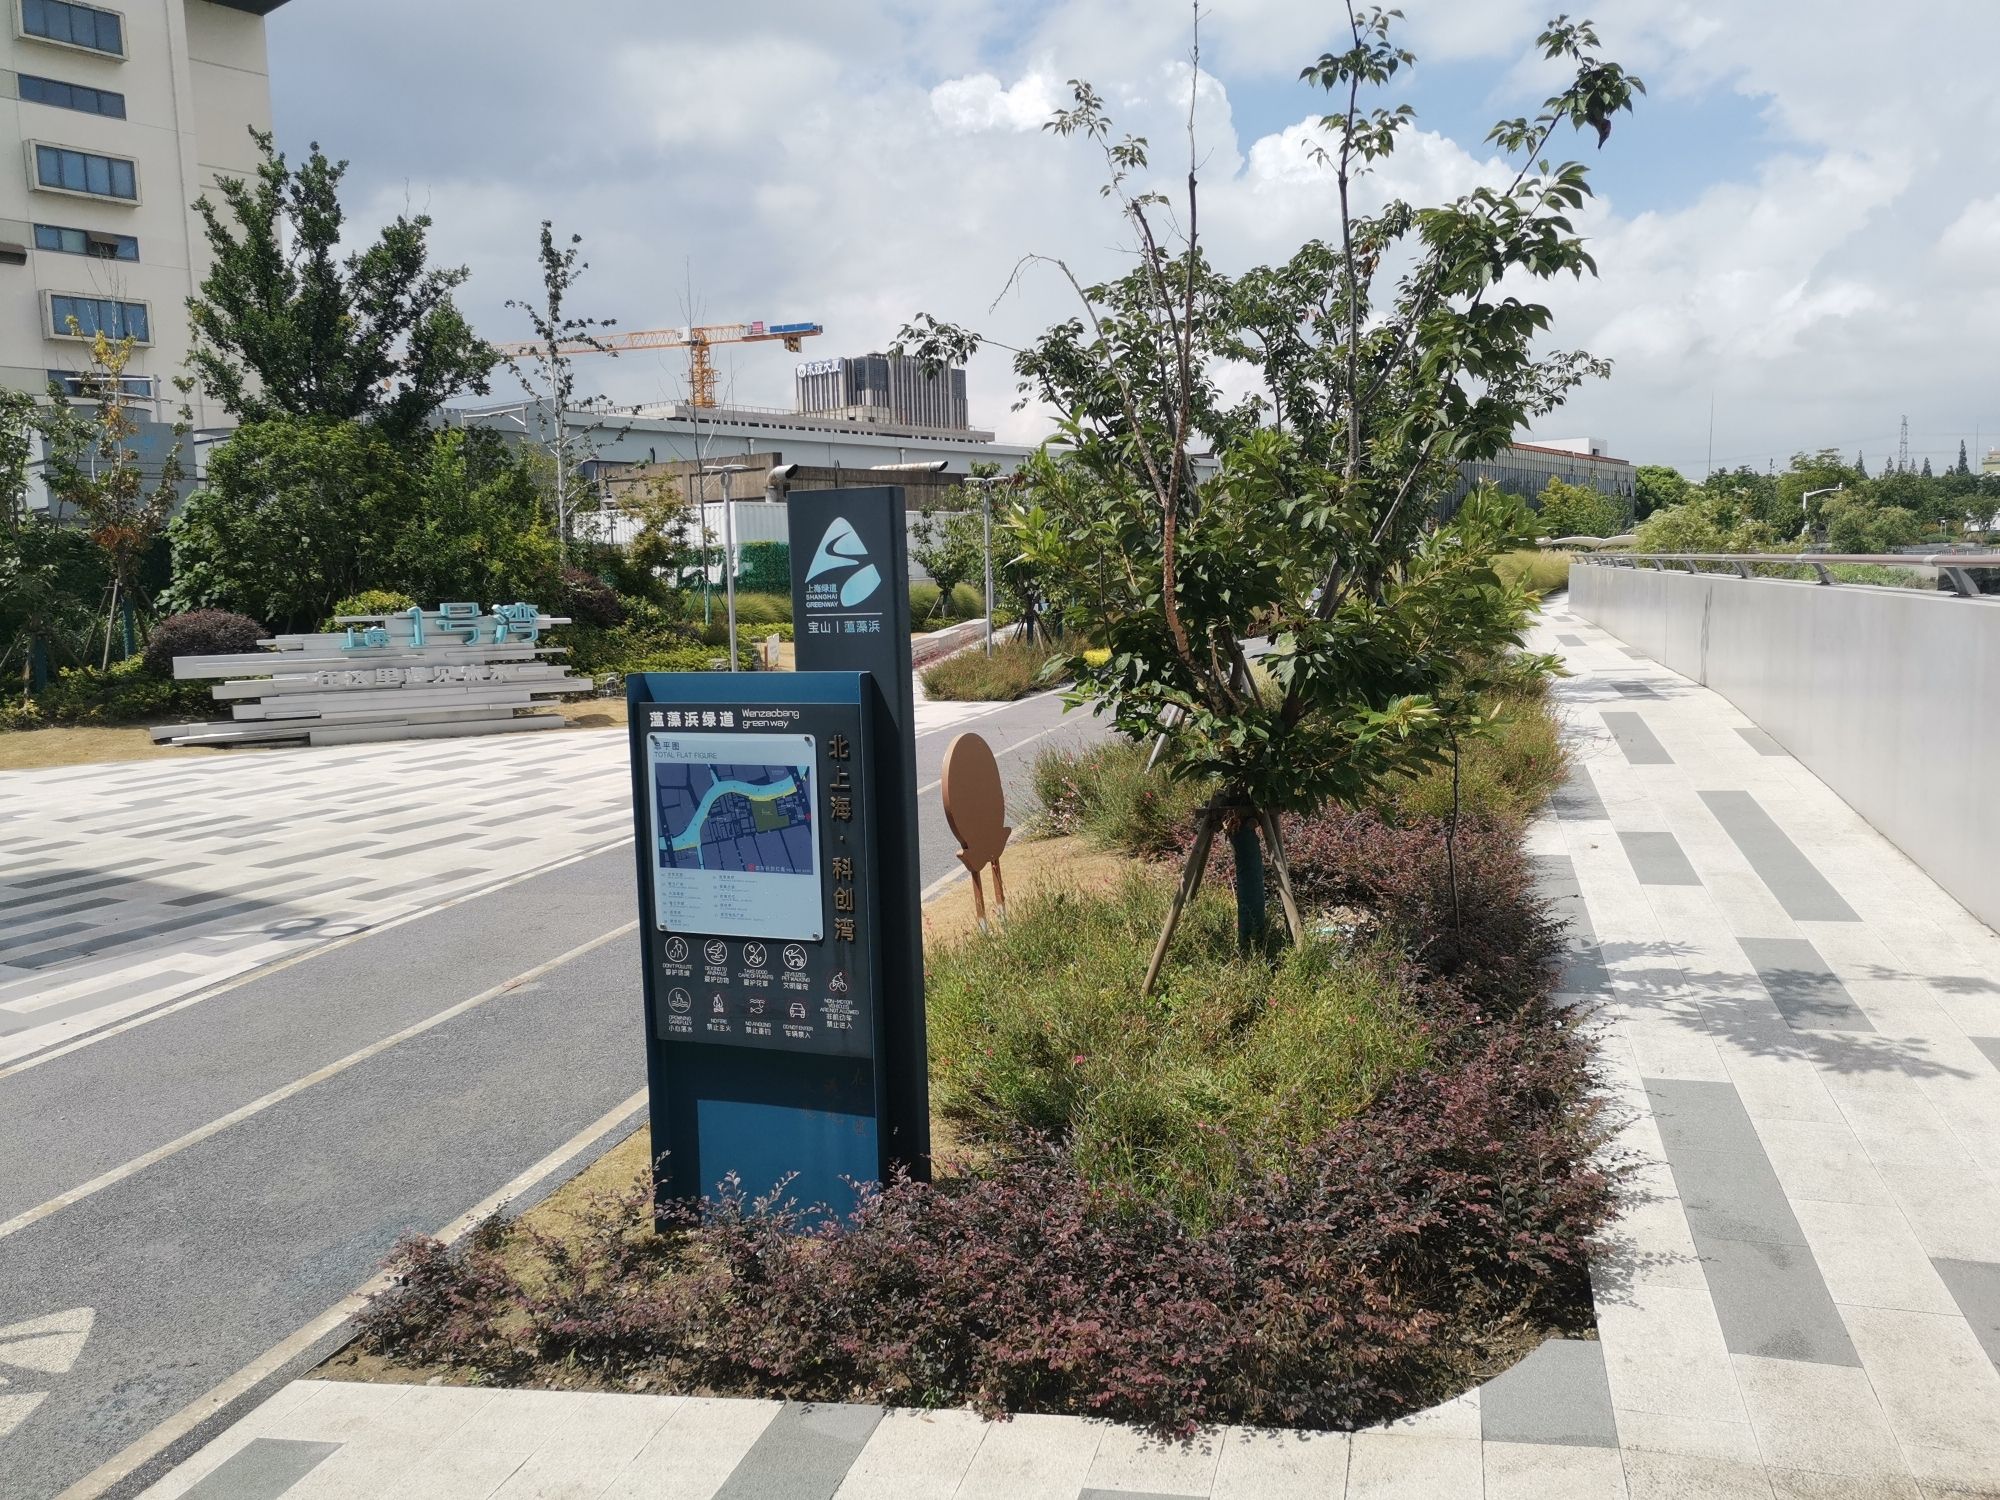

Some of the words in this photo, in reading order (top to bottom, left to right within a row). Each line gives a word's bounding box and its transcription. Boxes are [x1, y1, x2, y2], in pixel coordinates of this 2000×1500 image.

[806, 593, 838, 601] SHANGHAI
[808, 621, 831, 634] 宝山
[741, 708, 800, 719] Wenzaobang
